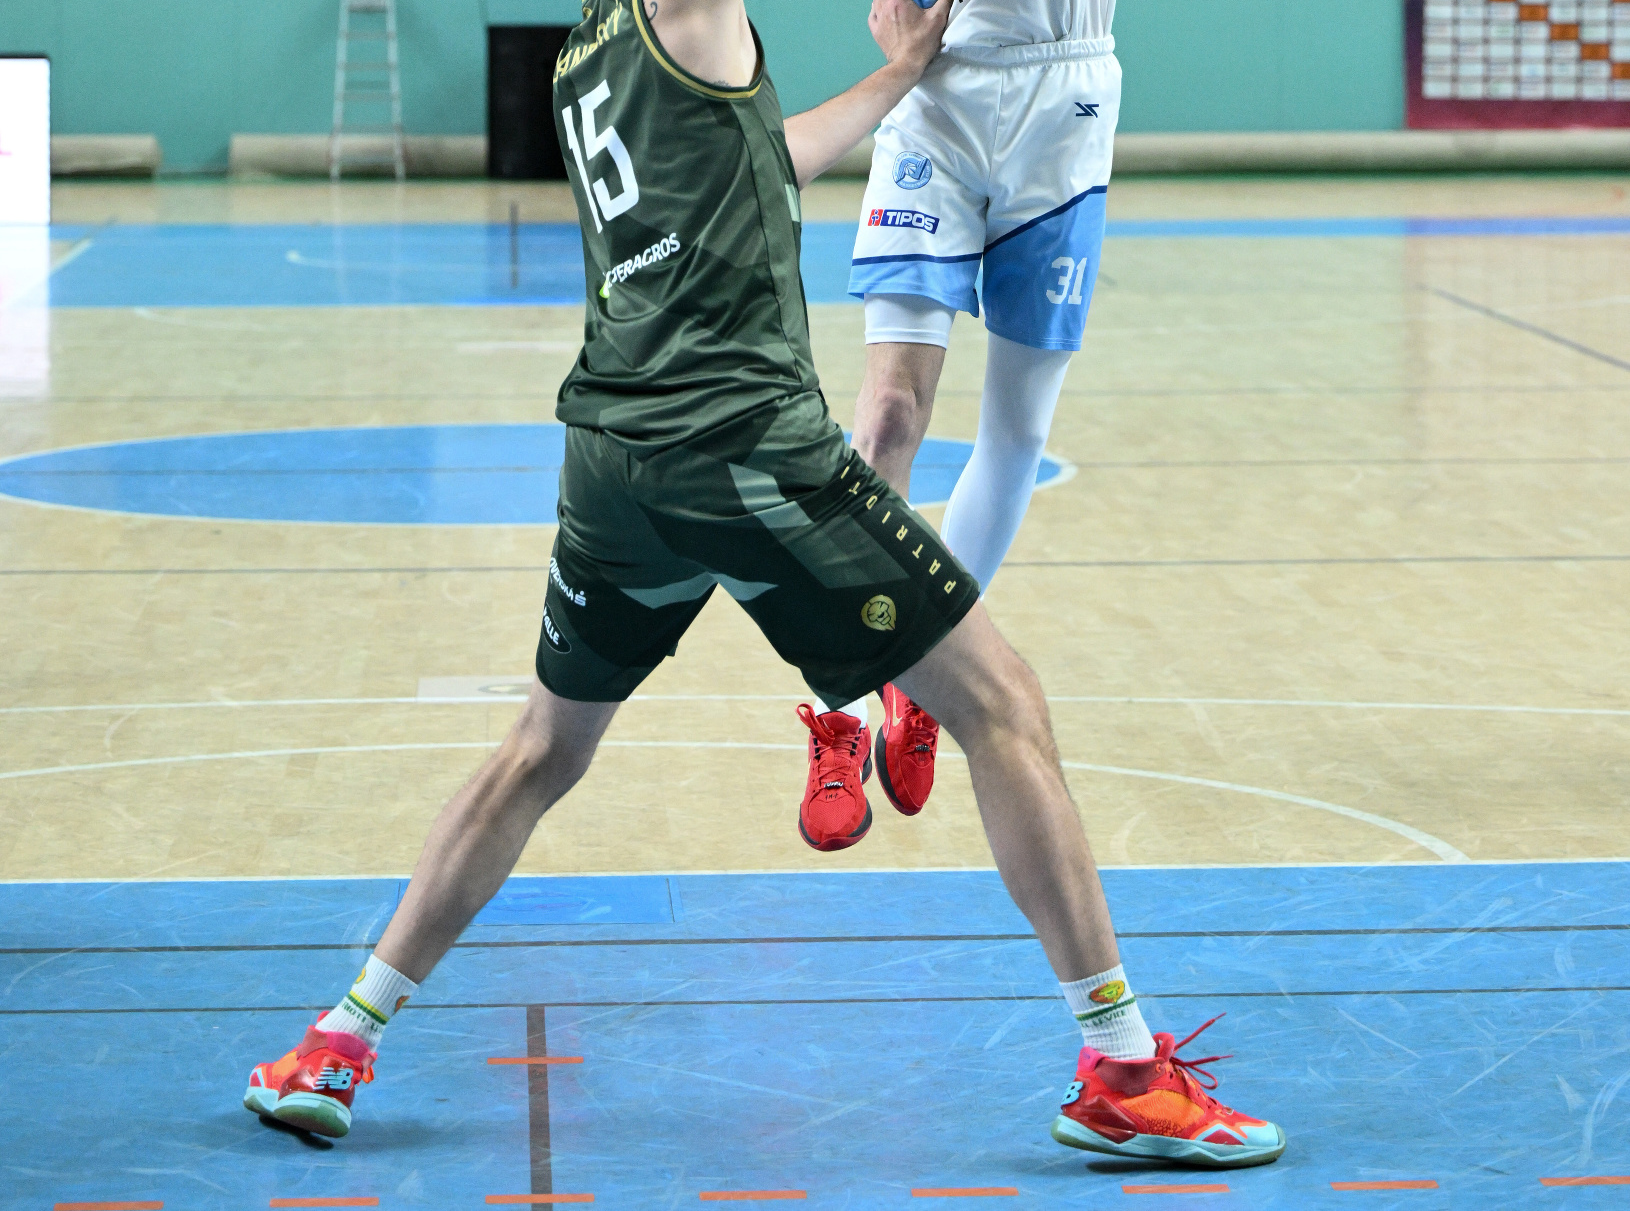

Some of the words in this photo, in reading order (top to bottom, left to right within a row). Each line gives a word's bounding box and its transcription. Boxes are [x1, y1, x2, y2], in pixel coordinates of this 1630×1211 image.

[561, 79, 640, 234] 15
[886, 211, 935, 231] TIPOS
[1045, 256, 1088, 305] 31
